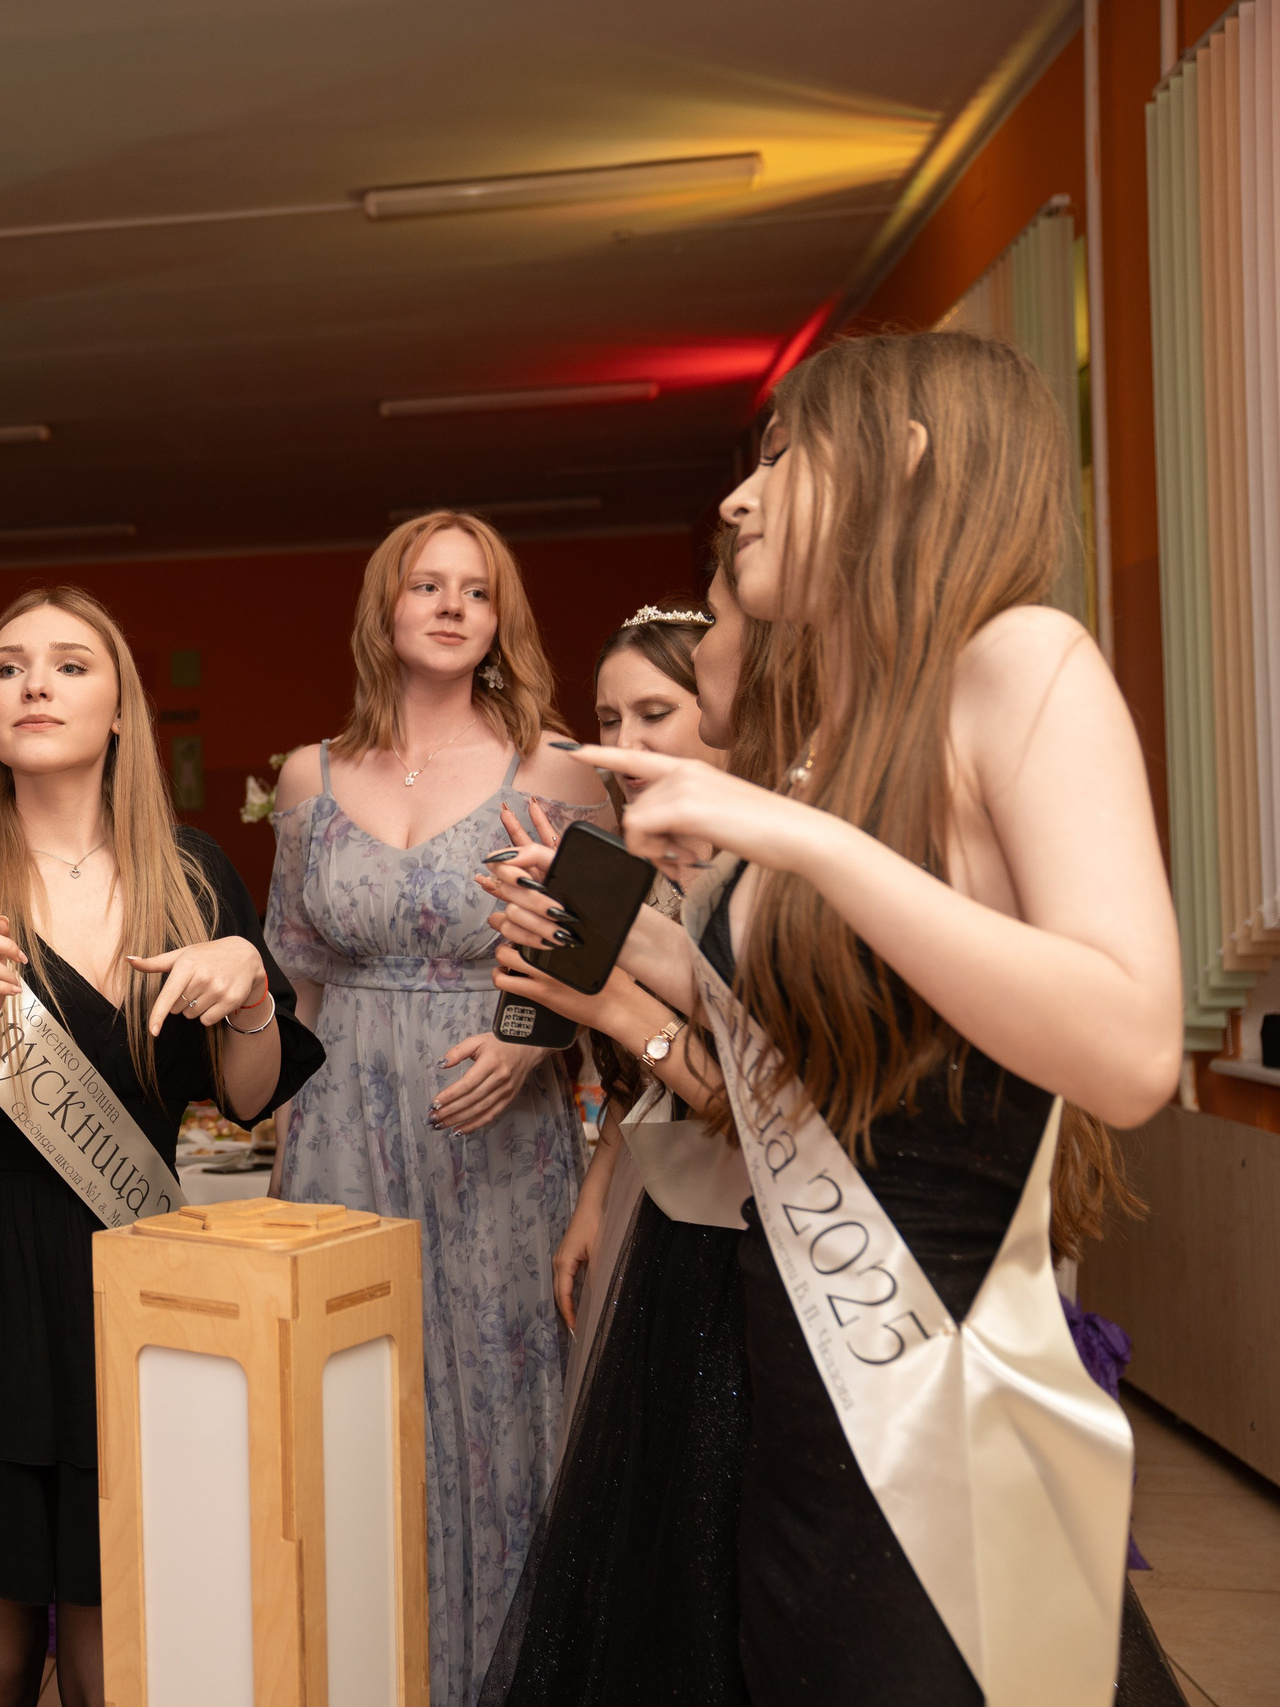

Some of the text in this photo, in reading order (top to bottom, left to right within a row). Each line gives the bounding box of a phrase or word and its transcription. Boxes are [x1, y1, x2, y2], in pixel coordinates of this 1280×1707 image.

[19, 999, 120, 1125] Хоменко Полина
[11, 1101, 57, 1156] Средняя
[54, 1154, 83, 1185] школа
[81, 1181, 102, 1204] №1
[781, 1168, 930, 1368] 2025
